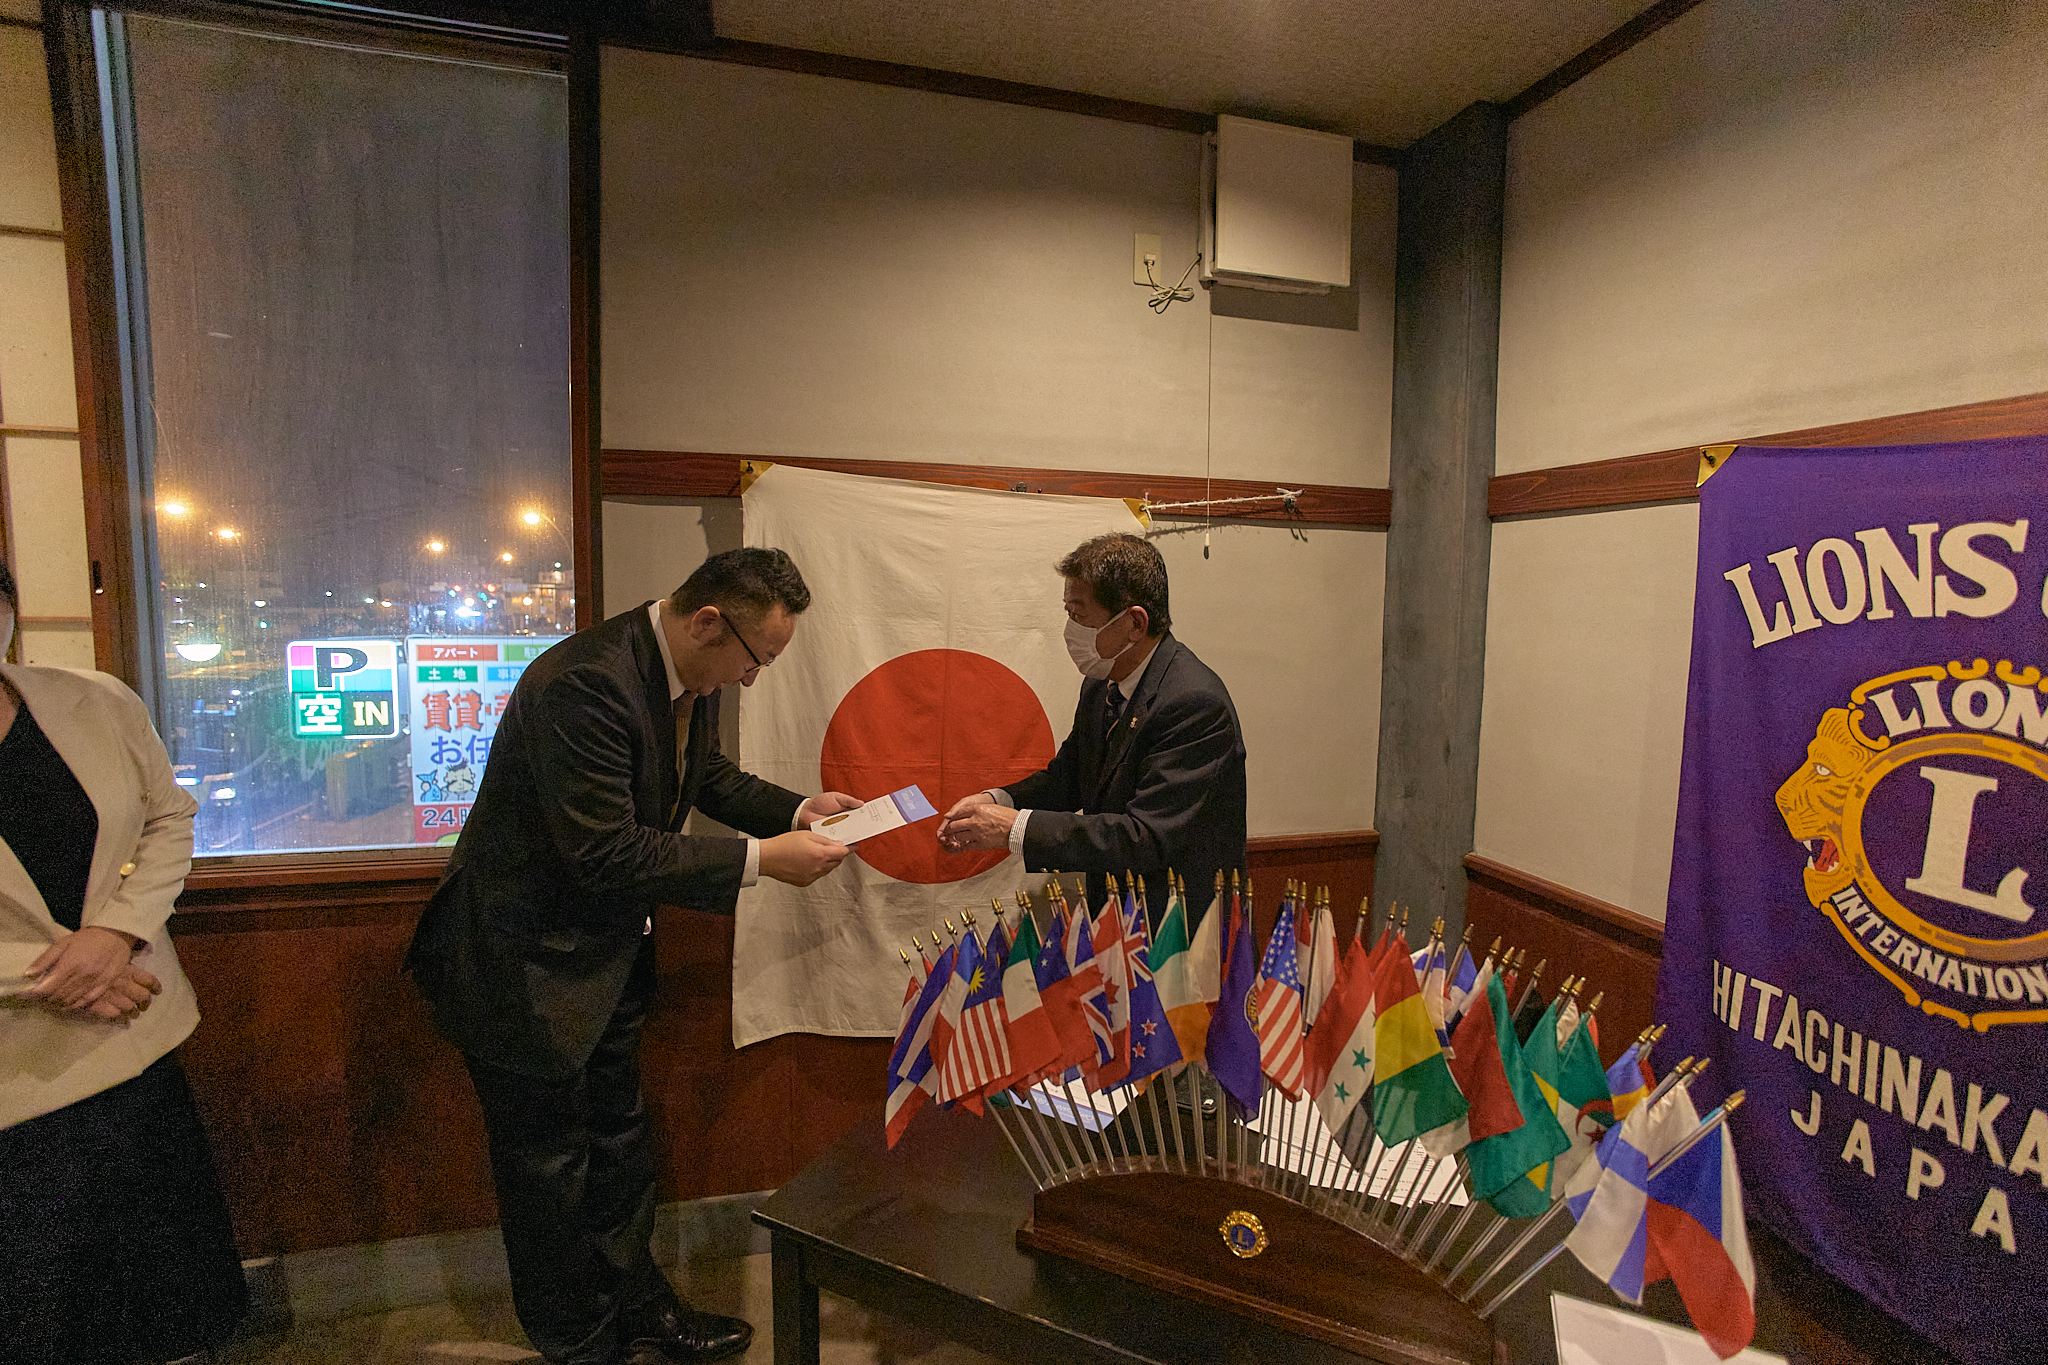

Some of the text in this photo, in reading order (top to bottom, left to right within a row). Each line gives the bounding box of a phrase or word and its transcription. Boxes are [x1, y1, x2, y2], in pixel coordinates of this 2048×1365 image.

[1723, 519, 2029, 649] LIONS
[316, 648, 367, 687] P
[433, 647, 478, 659] アパート
[299, 693, 342, 732] 空
[353, 701, 389, 726] IN
[1905, 766, 2034, 923] L
[1713, 958, 2048, 1188] HITACHINAKA
